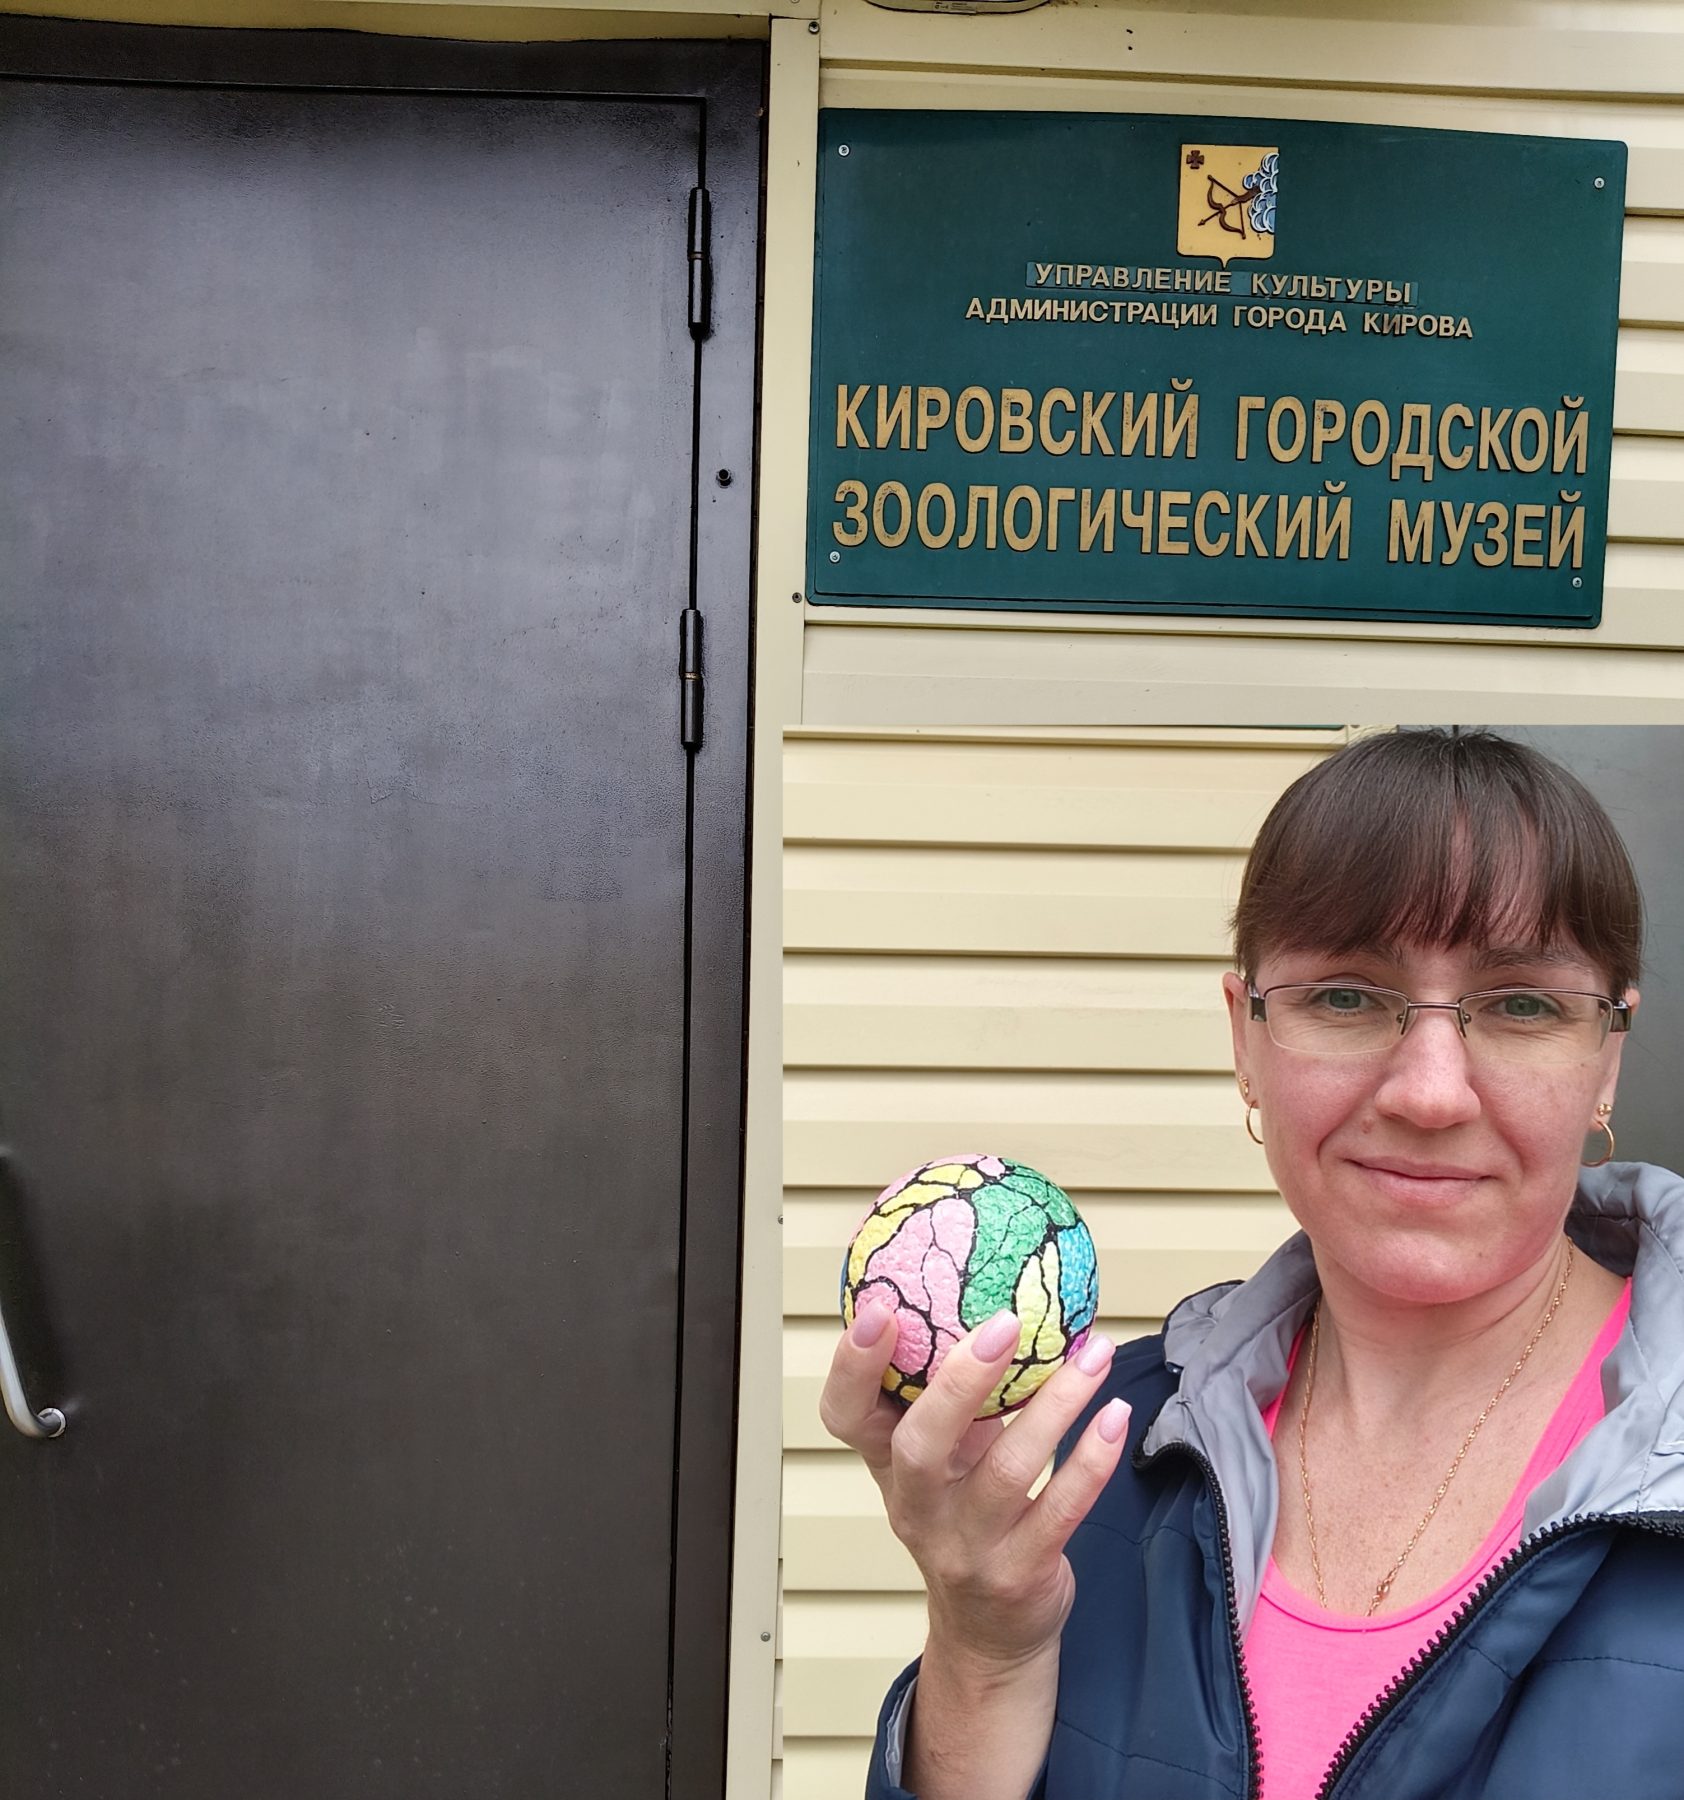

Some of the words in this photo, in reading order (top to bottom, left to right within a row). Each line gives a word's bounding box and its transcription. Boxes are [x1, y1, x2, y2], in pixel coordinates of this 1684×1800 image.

[1034, 262, 1231, 293] УПРАВЛЕНИЕ
[1251, 272, 1412, 304] КУЛЬТУРЫ
[965, 297, 1218, 328] АДМИНИСТРАЦИИ
[1233, 305, 1347, 335] ГОРОДА
[1363, 312, 1473, 339] КИРОВА
[835, 377, 1199, 458] КИРОВСКИЙ
[1236, 395, 1589, 482] ГОРОДСКОЙ
[832, 480, 1352, 560] ЗООЛОГИЧЕСКИЙ
[1388, 491, 1586, 569] МУЗЕЙ
